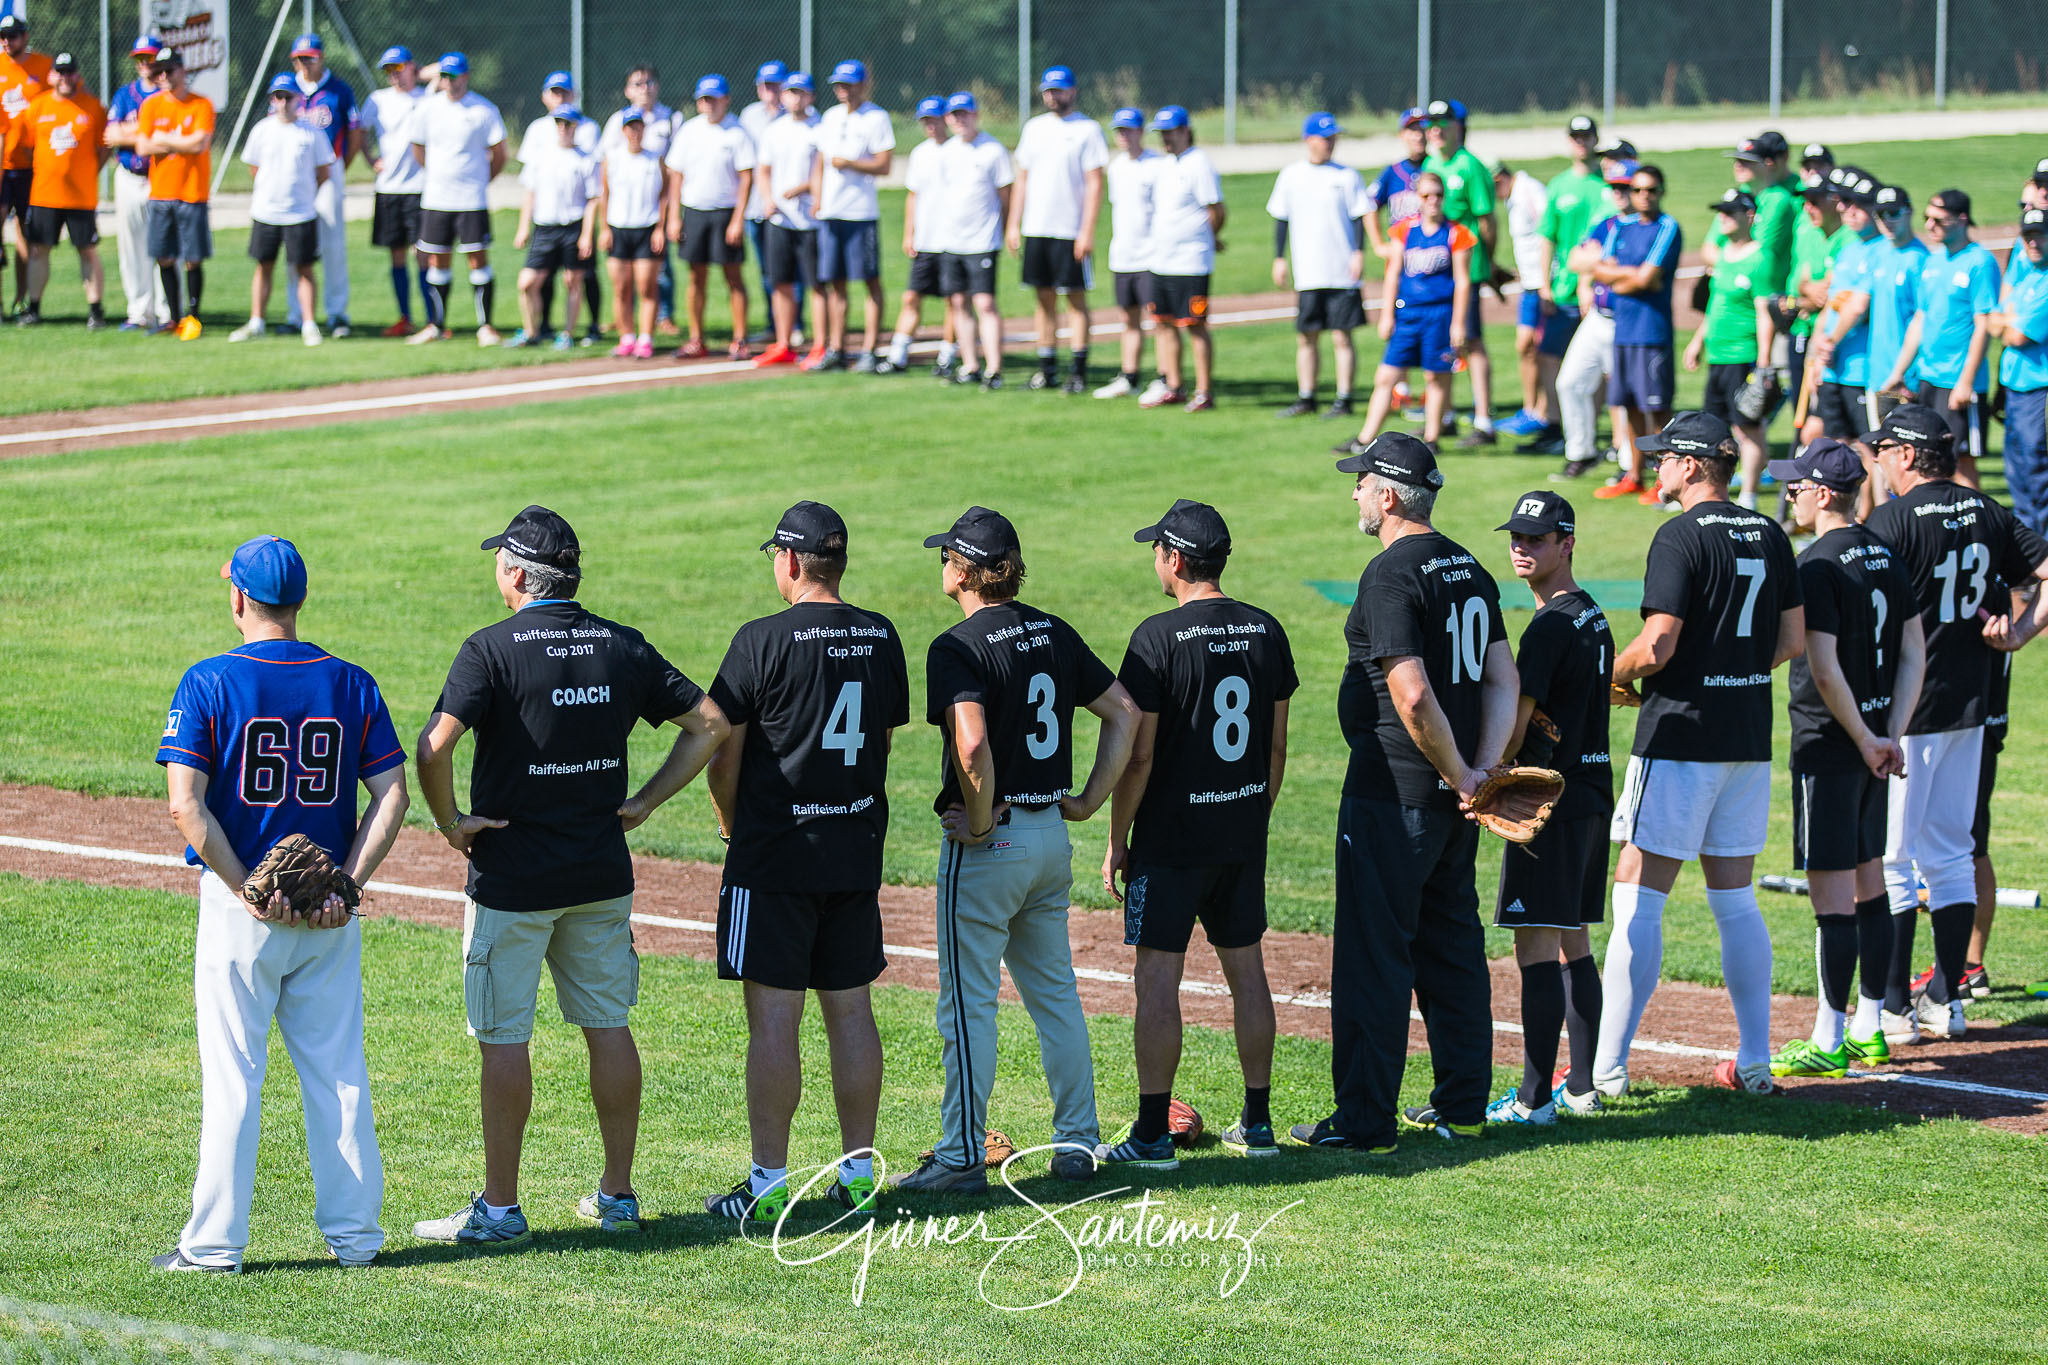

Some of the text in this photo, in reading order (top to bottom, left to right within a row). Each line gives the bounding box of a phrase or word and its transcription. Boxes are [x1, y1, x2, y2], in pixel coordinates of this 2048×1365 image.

[1452, 568, 1471, 582] 2016
[1934, 543, 1990, 624] 13
[1736, 558, 1767, 637] 7
[513, 627, 612, 643] Raiffeisen Baseball
[794, 626, 888, 642] Raiffeisen Baseball
[1175, 622, 1266, 642] Raiffeisen Baseball
[1030, 634, 1051, 647] 2017
[1208, 640, 1250, 655] Cup 2017
[1446, 596, 1489, 685] 10
[546, 643, 594, 659] Cup 2017
[827, 645, 873, 660] Cup 2017
[1703, 675, 1748, 687] Raiffeisen
[551, 685, 611, 706] COACH
[822, 681, 865, 766] 4
[1026, 672, 1060, 760] 3
[1213, 675, 1250, 762] 8
[240, 717, 344, 807] 69
[528, 763, 583, 775] Raiffeisen
[585, 759, 600, 772] All
[1004, 792, 1052, 804] Raiffeisen
[1053, 789, 1062, 802] All
[1189, 790, 1238, 804] Raiffeisen
[792, 804, 848, 815] Raiffeisen
[859, 795, 874, 810] Stars
